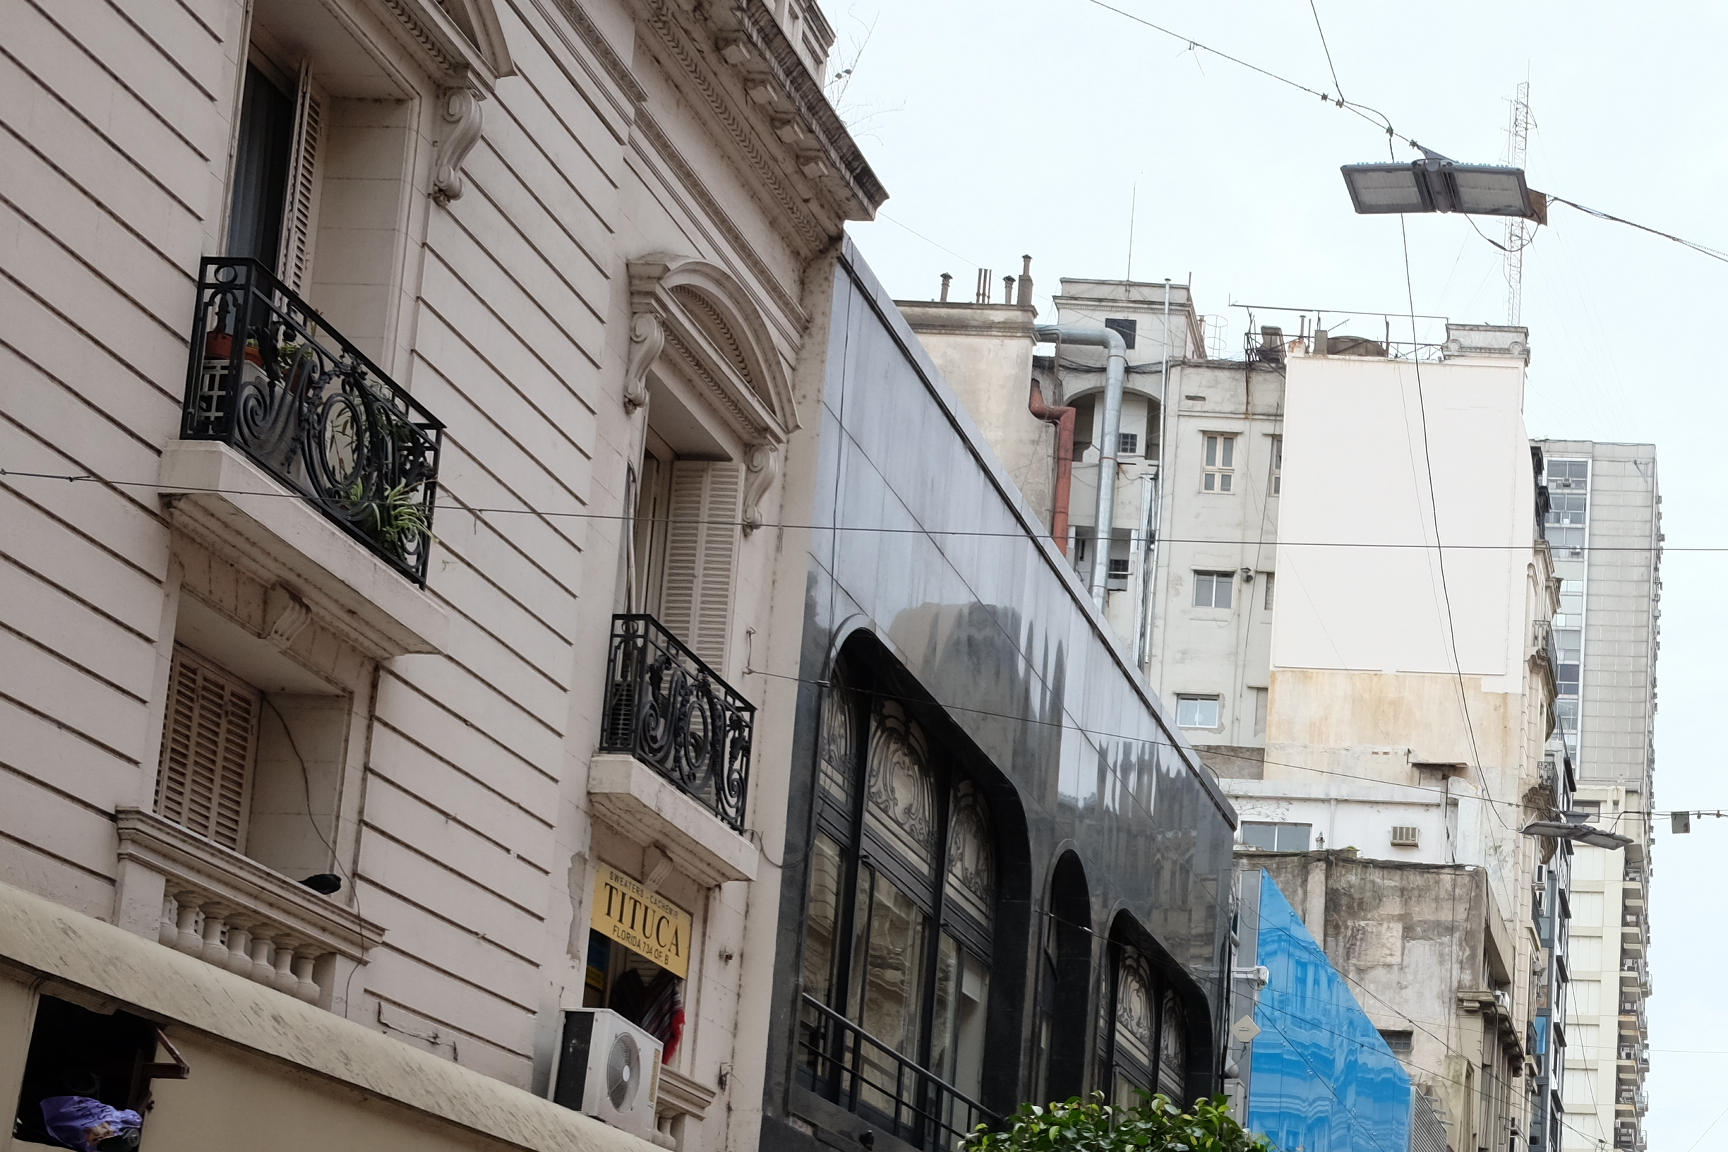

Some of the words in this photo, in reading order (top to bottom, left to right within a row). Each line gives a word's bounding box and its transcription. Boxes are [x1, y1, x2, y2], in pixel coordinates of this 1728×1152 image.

[609, 871, 645, 898] SWEATERS
[604, 882, 680, 958] TITUCA
[612, 925, 641, 950] FLORIDA
